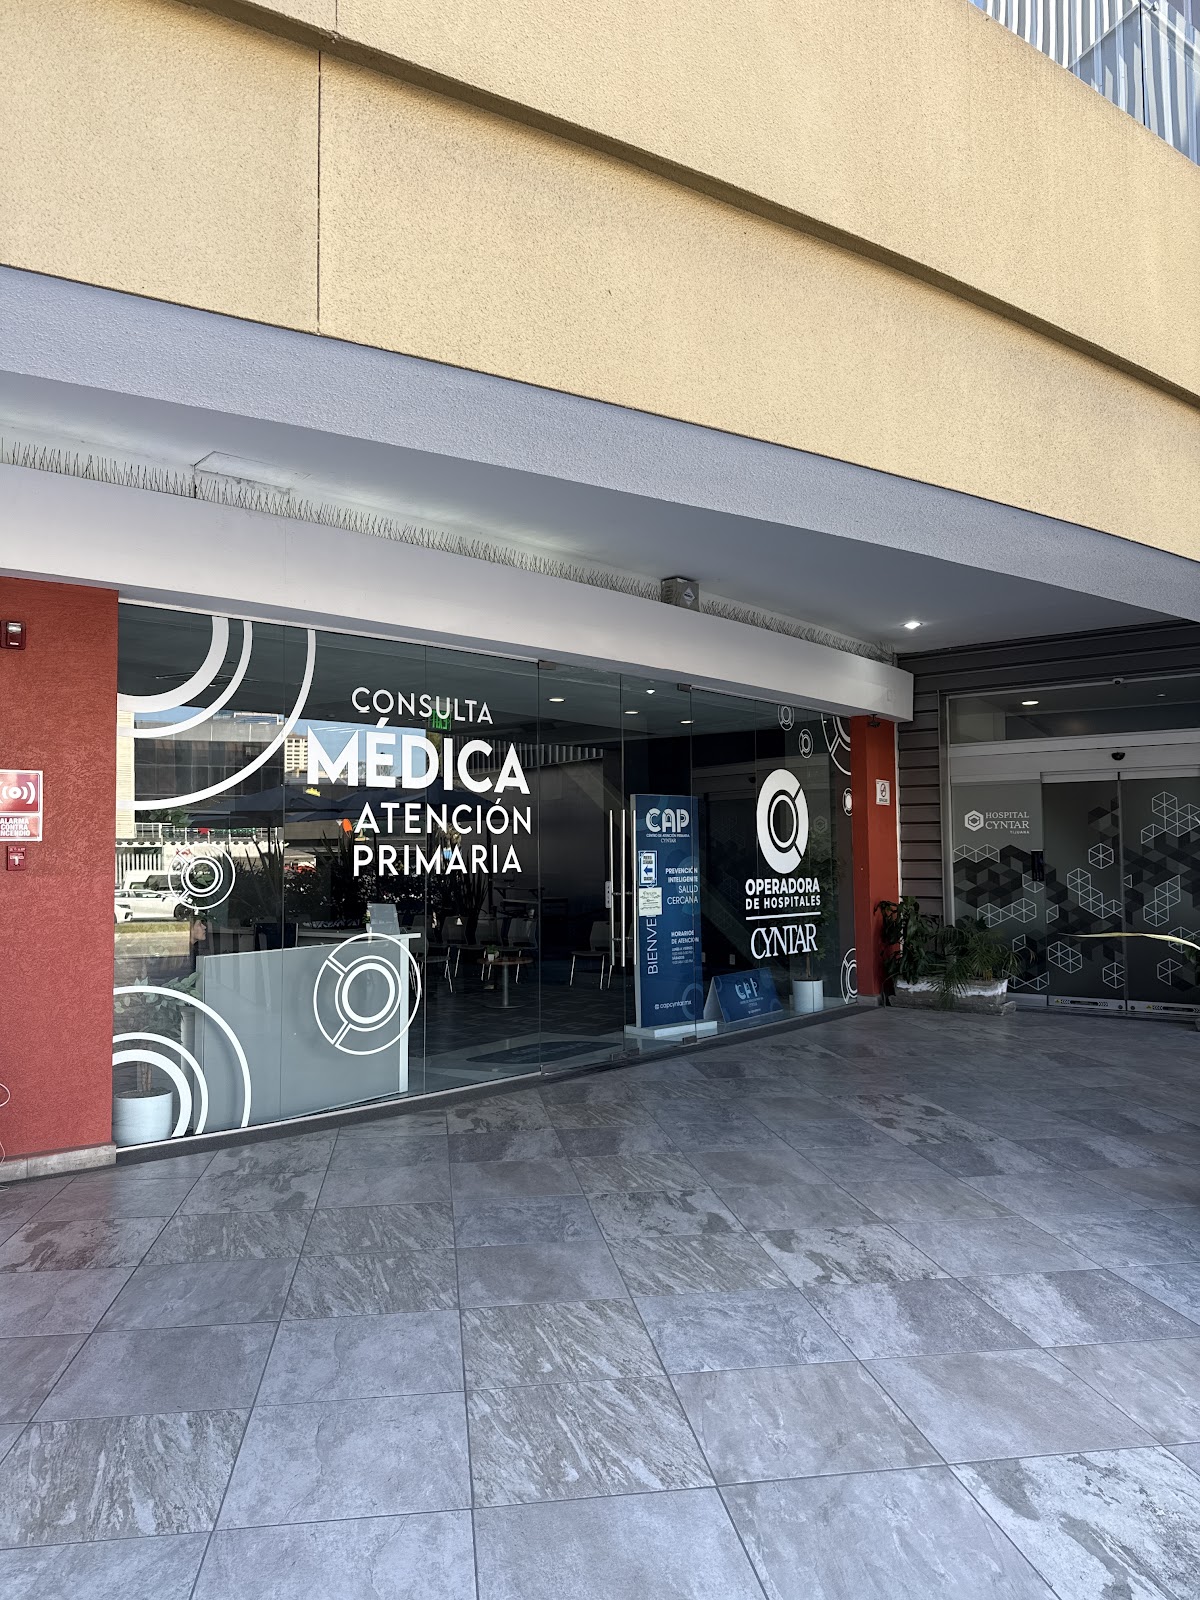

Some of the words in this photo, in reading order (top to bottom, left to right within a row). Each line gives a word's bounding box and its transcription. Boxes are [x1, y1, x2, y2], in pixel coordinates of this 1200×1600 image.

[351, 686, 493, 725] CONSULTA
[307, 717, 531, 795] MÉDICA
[0, 817, 29, 825] ALARMA
[353, 798, 532, 835] ATENCIÓN
[646, 808, 690, 833] CAP
[985, 811, 1030, 819] HOSPITAL
[985, 820, 1030, 830] CYNTAR
[353, 844, 523, 877] PRIMARIA
[665, 865, 698, 875] PREVENCIÓN
[668, 875, 698, 884] INTELIGENTE
[745, 877, 820, 896] OPERADORA
[678, 884, 698, 894] SALUD
[666, 895, 698, 906] CERCANA
[745, 897, 760, 911] DE
[763, 895, 821, 909] HOSPITALES
[646, 915, 659, 975] BIENVE
[750, 923, 819, 960] CYNTAR
